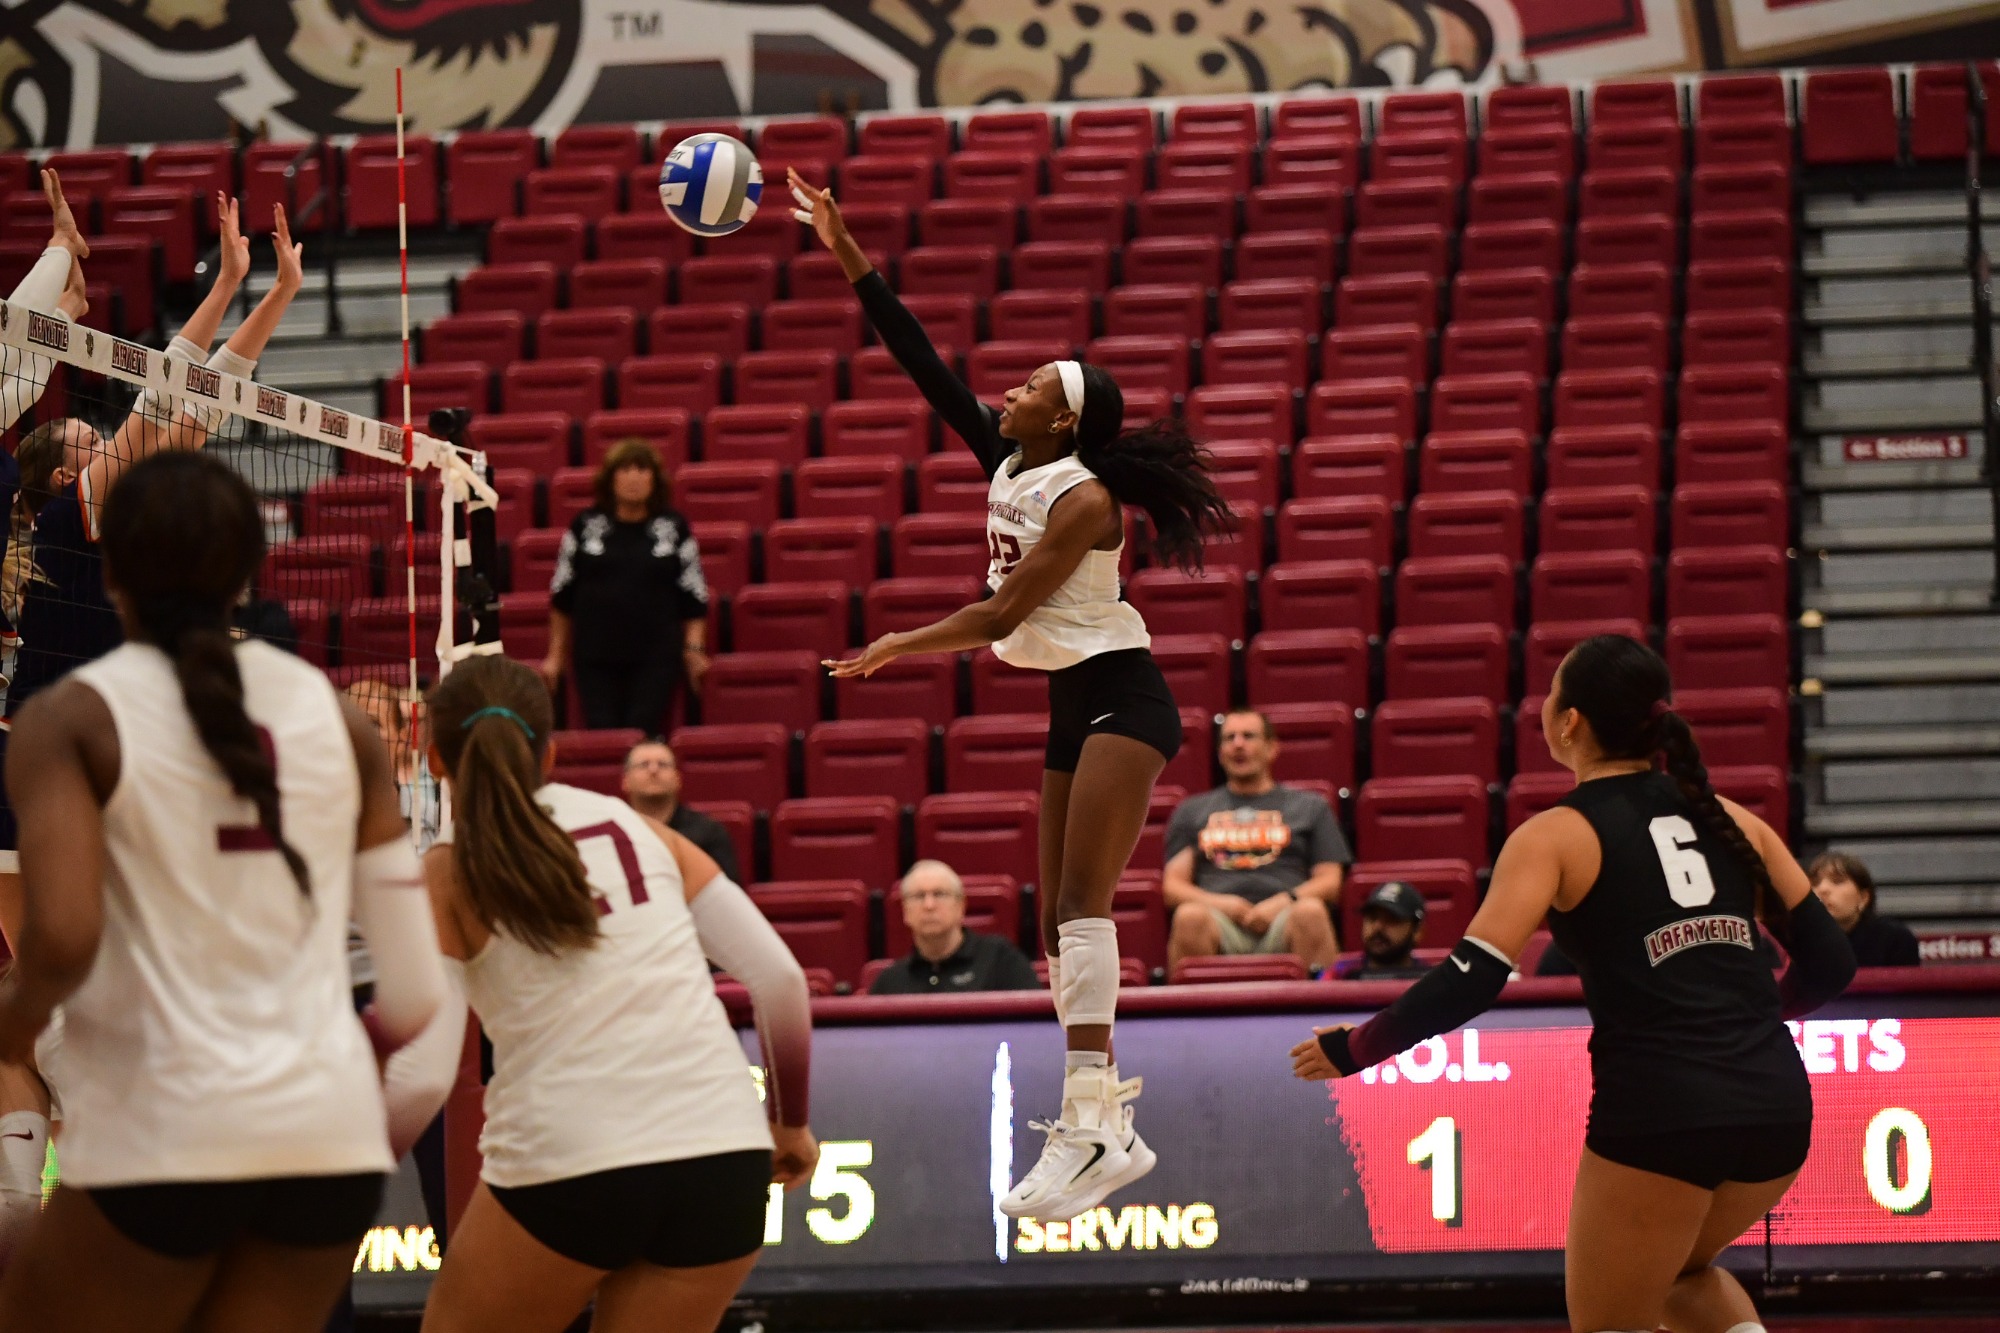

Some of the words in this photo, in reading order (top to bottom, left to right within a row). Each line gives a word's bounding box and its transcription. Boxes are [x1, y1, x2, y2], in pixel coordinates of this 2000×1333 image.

[605, 11, 663, 38] TM
[566, 820, 650, 917] 7
[1649, 815, 1716, 908] 6
[1648, 916, 1752, 963] LAFAYETTE
[1918, 936, 1984, 958] ection
[1361, 1029, 1511, 1084] .O.L.
[1407, 1116, 1456, 1221] 1
[1862, 1107, 1932, 1212] 0
[1015, 1202, 1219, 1252] SERVING
